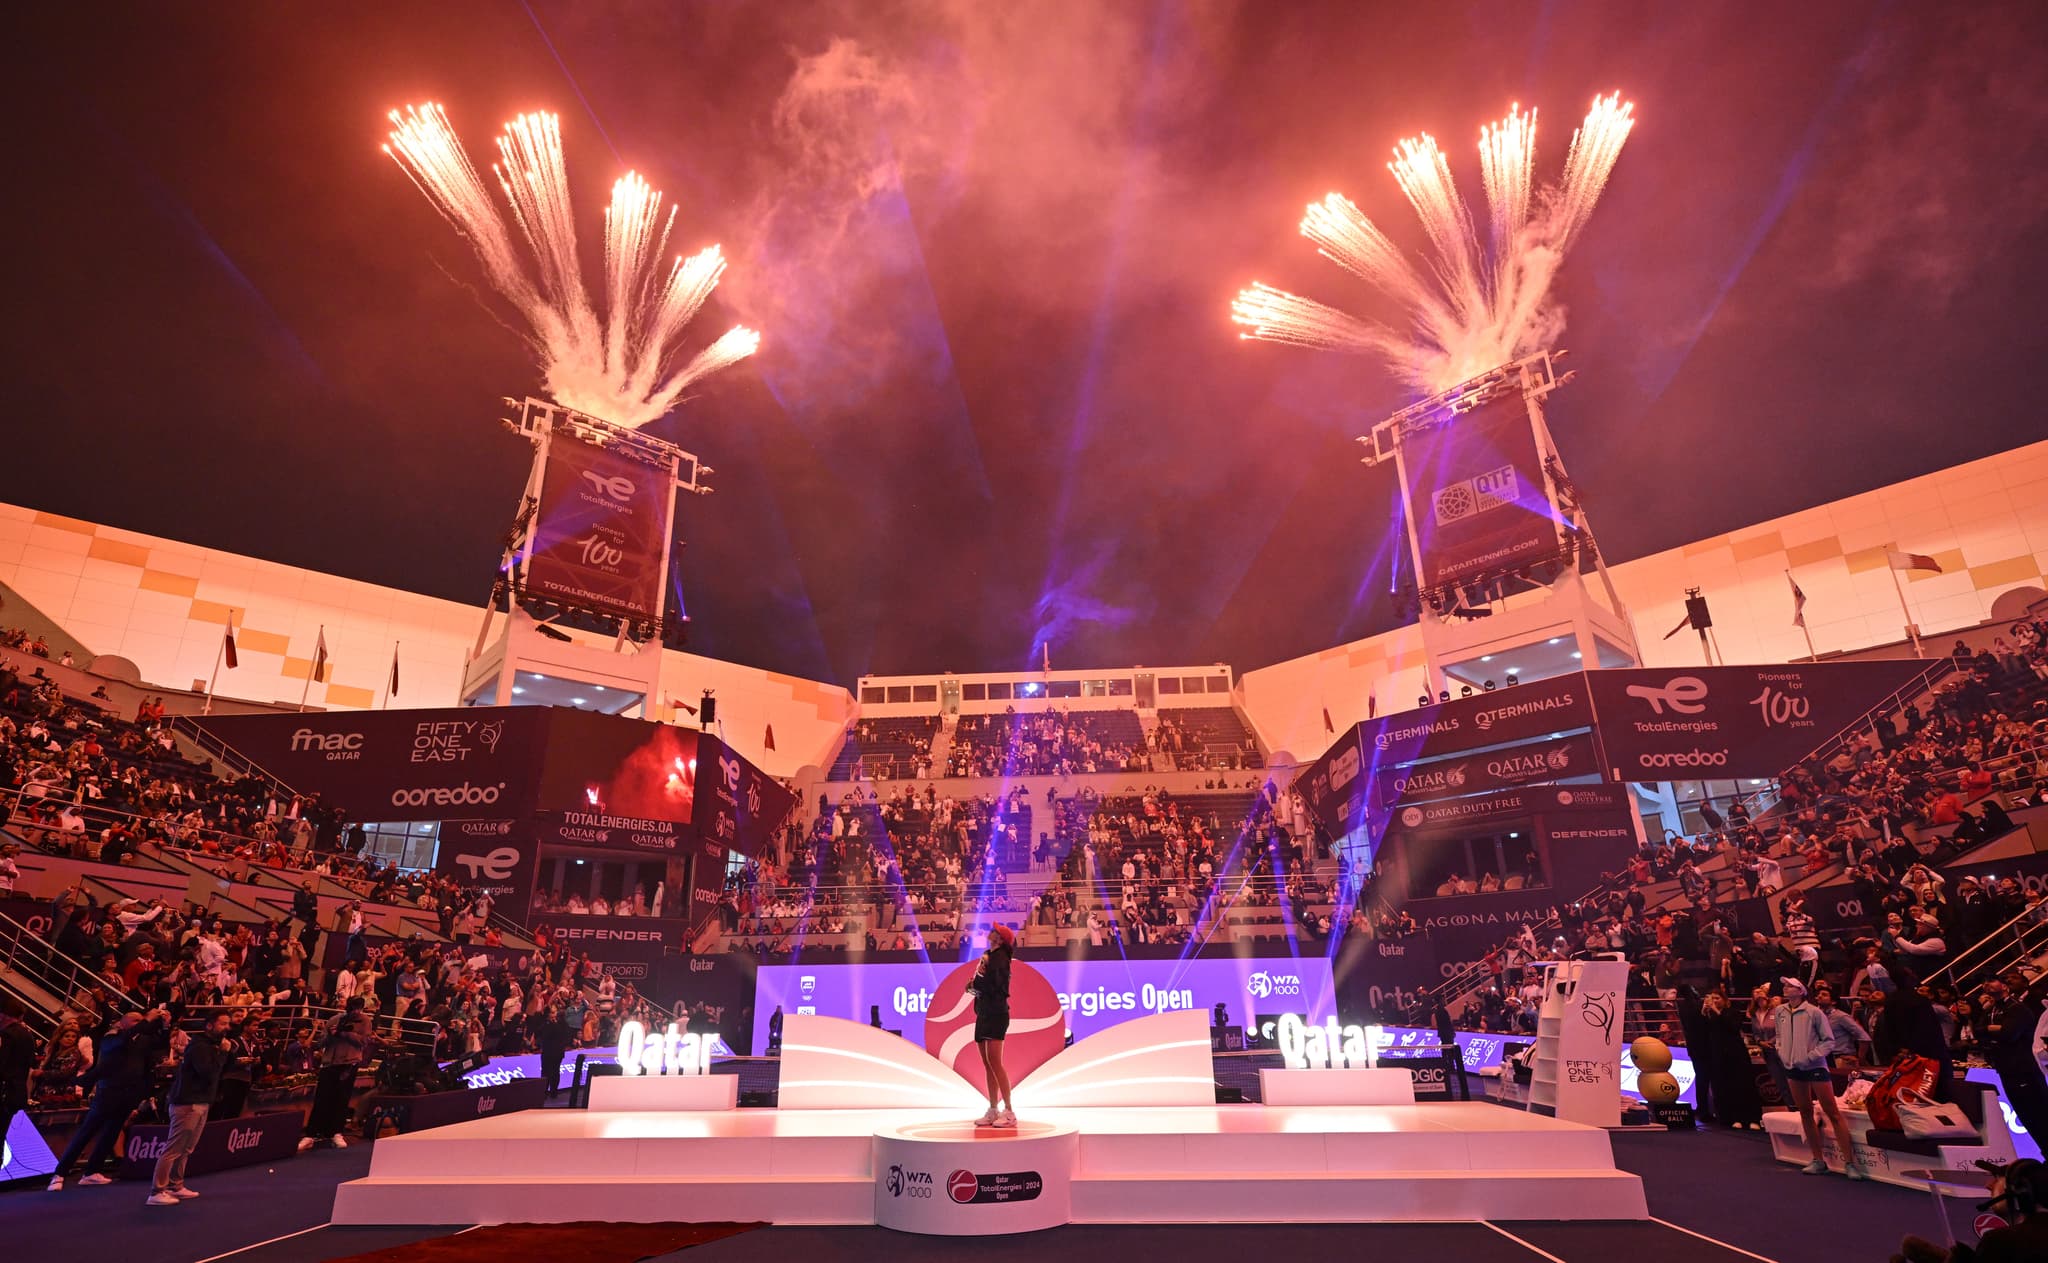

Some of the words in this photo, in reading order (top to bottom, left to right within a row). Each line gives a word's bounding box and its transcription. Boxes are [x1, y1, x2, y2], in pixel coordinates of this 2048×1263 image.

[1477, 466, 1513, 494] QTF
[580, 492, 633, 515] TotalEnergies
[592, 522, 624, 538] Pioneers
[613, 536, 624, 545] for
[576, 534, 623, 565] 100
[1438, 538, 1539, 576] QATARTENNIS.COM
[543, 580, 644, 612] TOTALENERGIES.QA
[1758, 672, 1801, 682] Pioneers
[1788, 681, 1803, 690] for
[1475, 694, 1573, 730] QTERMINALS
[1750, 686, 1810, 728] 100
[416, 721, 478, 736] FIFTY
[1634, 721, 1719, 733] TotalEnergies
[1789, 719, 1815, 728] years
[291, 729, 364, 752] fnac
[1375, 718, 1460, 750] QTERMINALS
[414, 735, 462, 749] ONE
[326, 751, 361, 761] QATAR
[410, 748, 472, 762] EAST
[1639, 748, 1729, 768] ooredoo
[1487, 753, 1546, 777] QATAR
[1394, 771, 1445, 793] QATAR
[391, 782, 506, 807] ooredoo
[1426, 805, 1460, 819] QATAR
[1462, 800, 1493, 814] DUTY
[1495, 797, 1522, 809] FREE
[461, 822, 497, 833] QATAR
[564, 811, 673, 833] TOTALENERGIES.QA
[559, 826, 597, 839] QATAR
[631, 833, 665, 845] QATAR
[1551, 829, 1628, 838] DEFENDER
[1419, 912, 1499, 928] AGOONA
[554, 927, 663, 942] DEFENDER
[1379, 942, 1405, 957] Qatar
[605, 965, 644, 976] SPORTS
[690, 958, 715, 972] Qatar
[1272, 975, 1300, 985] WTA
[1274, 985, 1299, 995] 1000
[1141, 983, 1193, 1014] Open
[617, 1020, 721, 1074] Qatar
[1277, 1012, 1384, 1069] Qatar
[1468, 1038, 1491, 1048] FIFTY
[1465, 1047, 1482, 1057] ONE
[1566, 1060, 1598, 1068] FIFTY
[1568, 1068, 1593, 1076] ONE
[1569, 1075, 1601, 1083] EAST
[477, 1095, 497, 1114] Qatar
[128, 1135, 169, 1162] Qata
[227, 1128, 263, 1153] Qatar
[906, 1171, 933, 1184] WTA
[907, 1186, 932, 1198] 1000
[980, 1183, 1022, 1192] TotalEnergies
[1025, 1181, 1040, 1190] 2024
